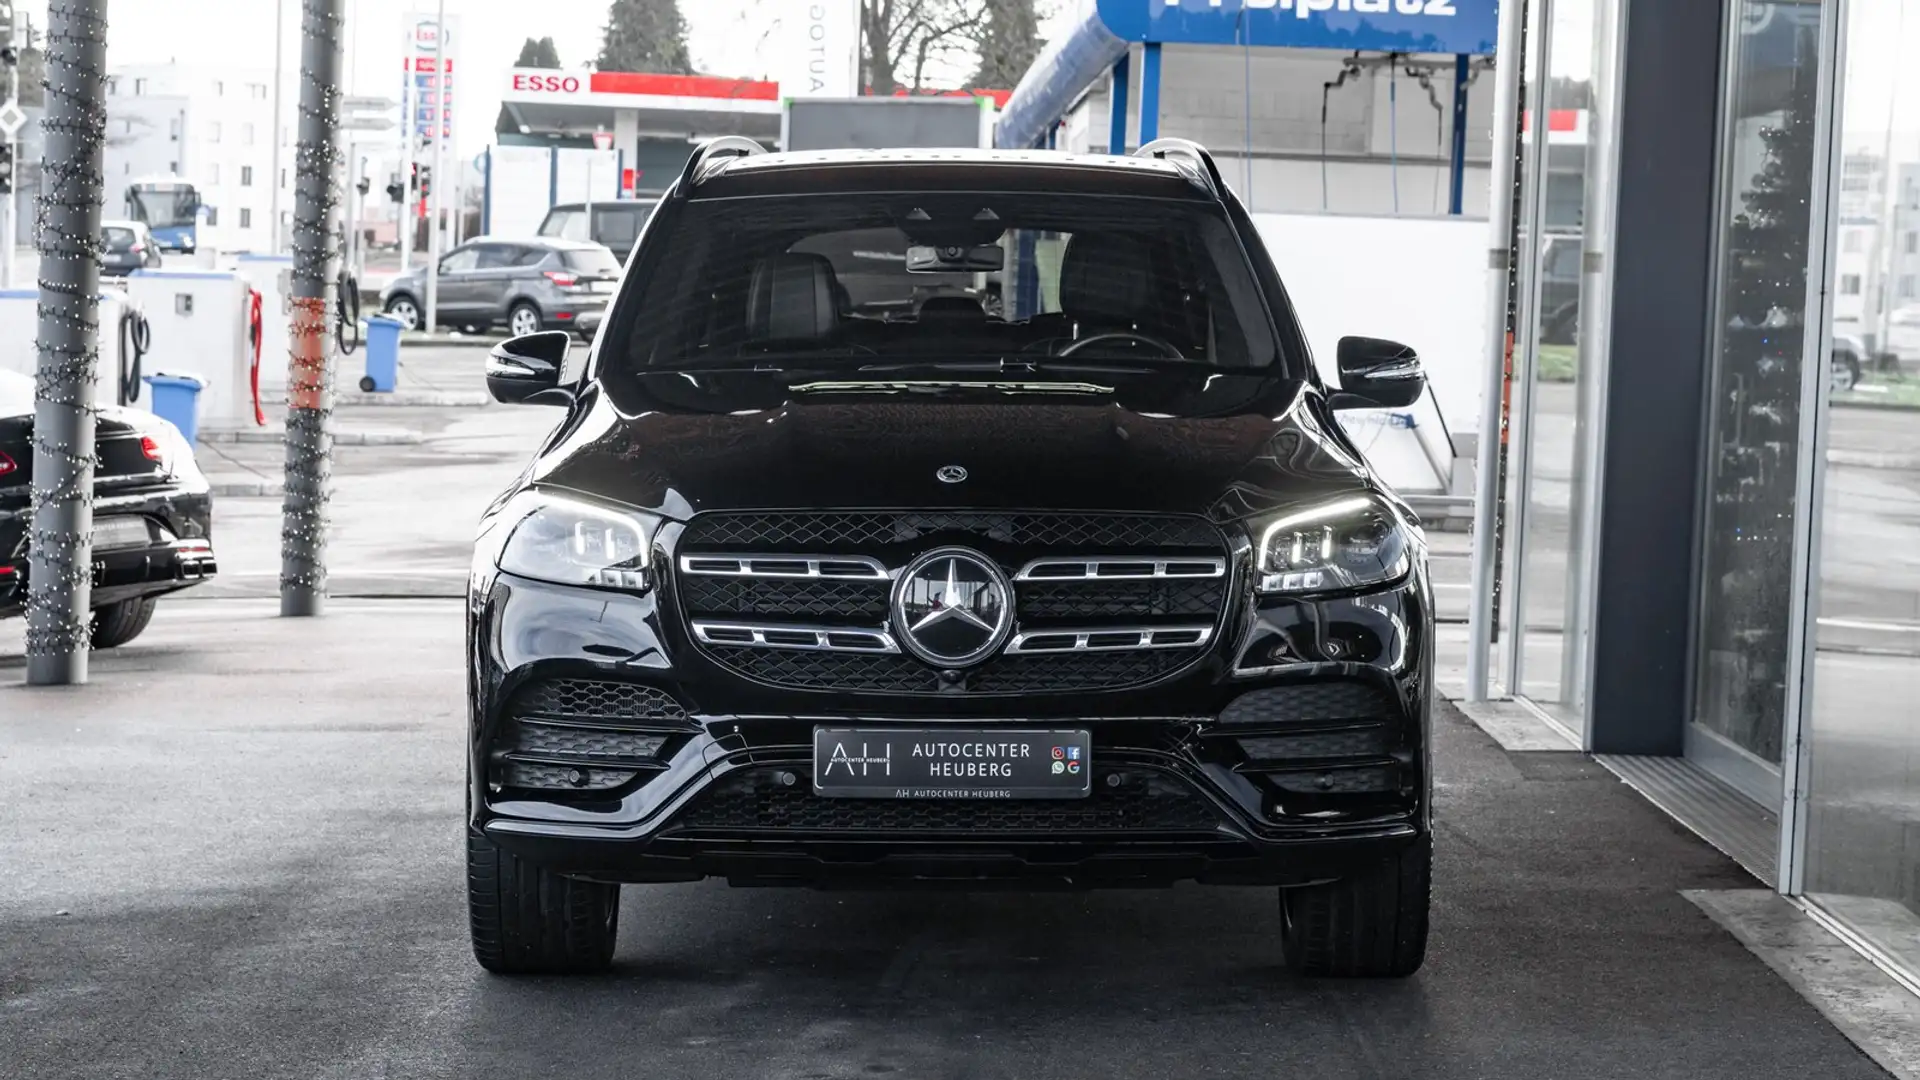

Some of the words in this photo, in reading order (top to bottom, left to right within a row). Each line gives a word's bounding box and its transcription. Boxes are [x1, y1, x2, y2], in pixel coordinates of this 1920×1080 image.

[513, 75, 579, 92] ESSO
[912, 743, 1030, 758] AUTOCENTER
[930, 762, 1012, 777] HEUBERG
[914, 789, 969, 798] AUTOCENTER
[971, 789, 1011, 798] HEUBERG
